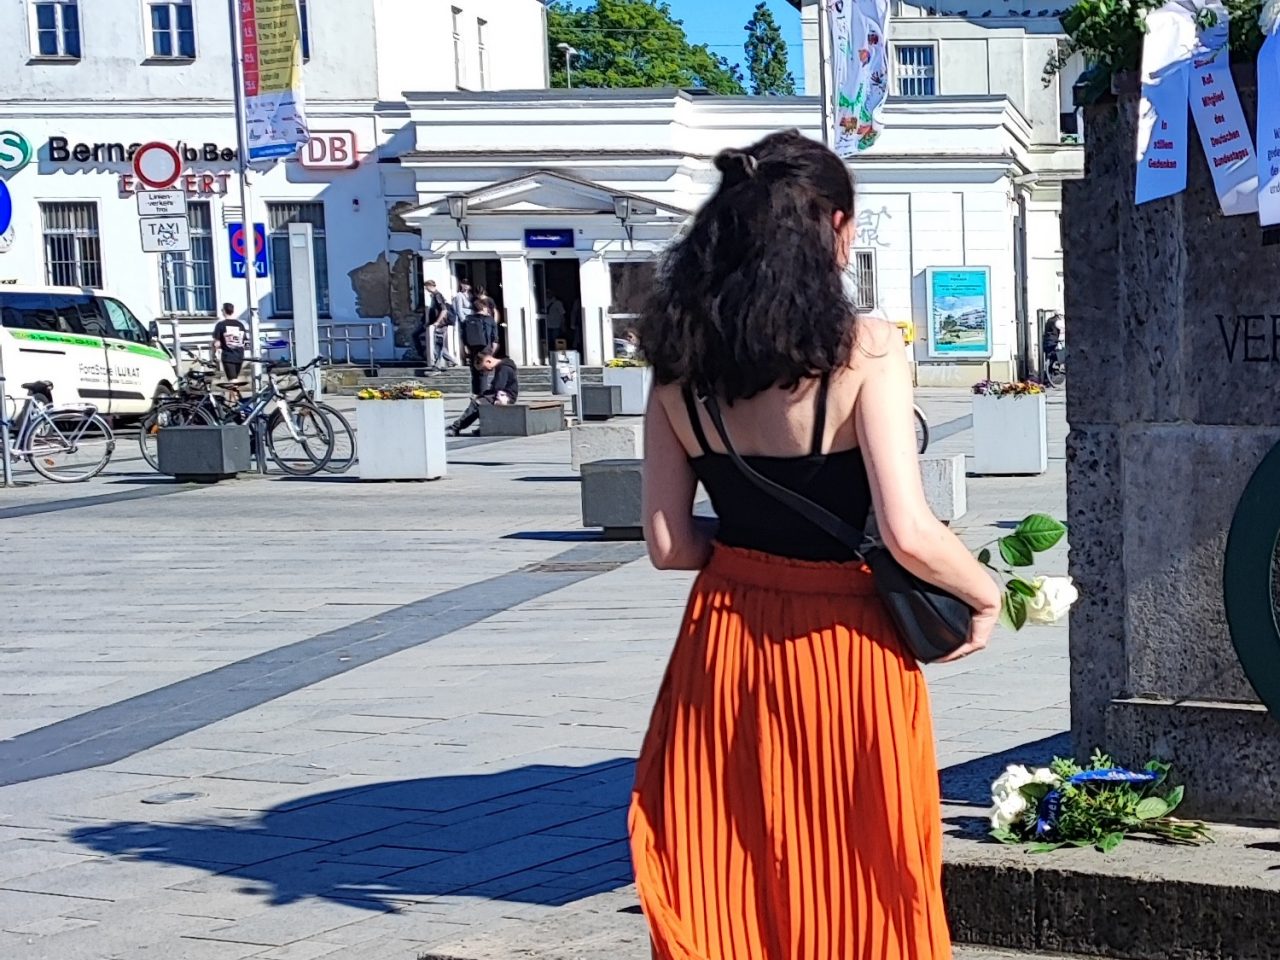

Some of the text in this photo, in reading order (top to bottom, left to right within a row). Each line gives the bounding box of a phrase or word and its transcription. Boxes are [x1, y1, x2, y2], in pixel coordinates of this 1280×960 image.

[49, 136, 140, 162] Berna
[308, 136, 348, 163] DB
[1148, 159, 1177, 168] Gedenken
[122, 174, 231, 194] EERT
[148, 223, 179, 236] TAXI
